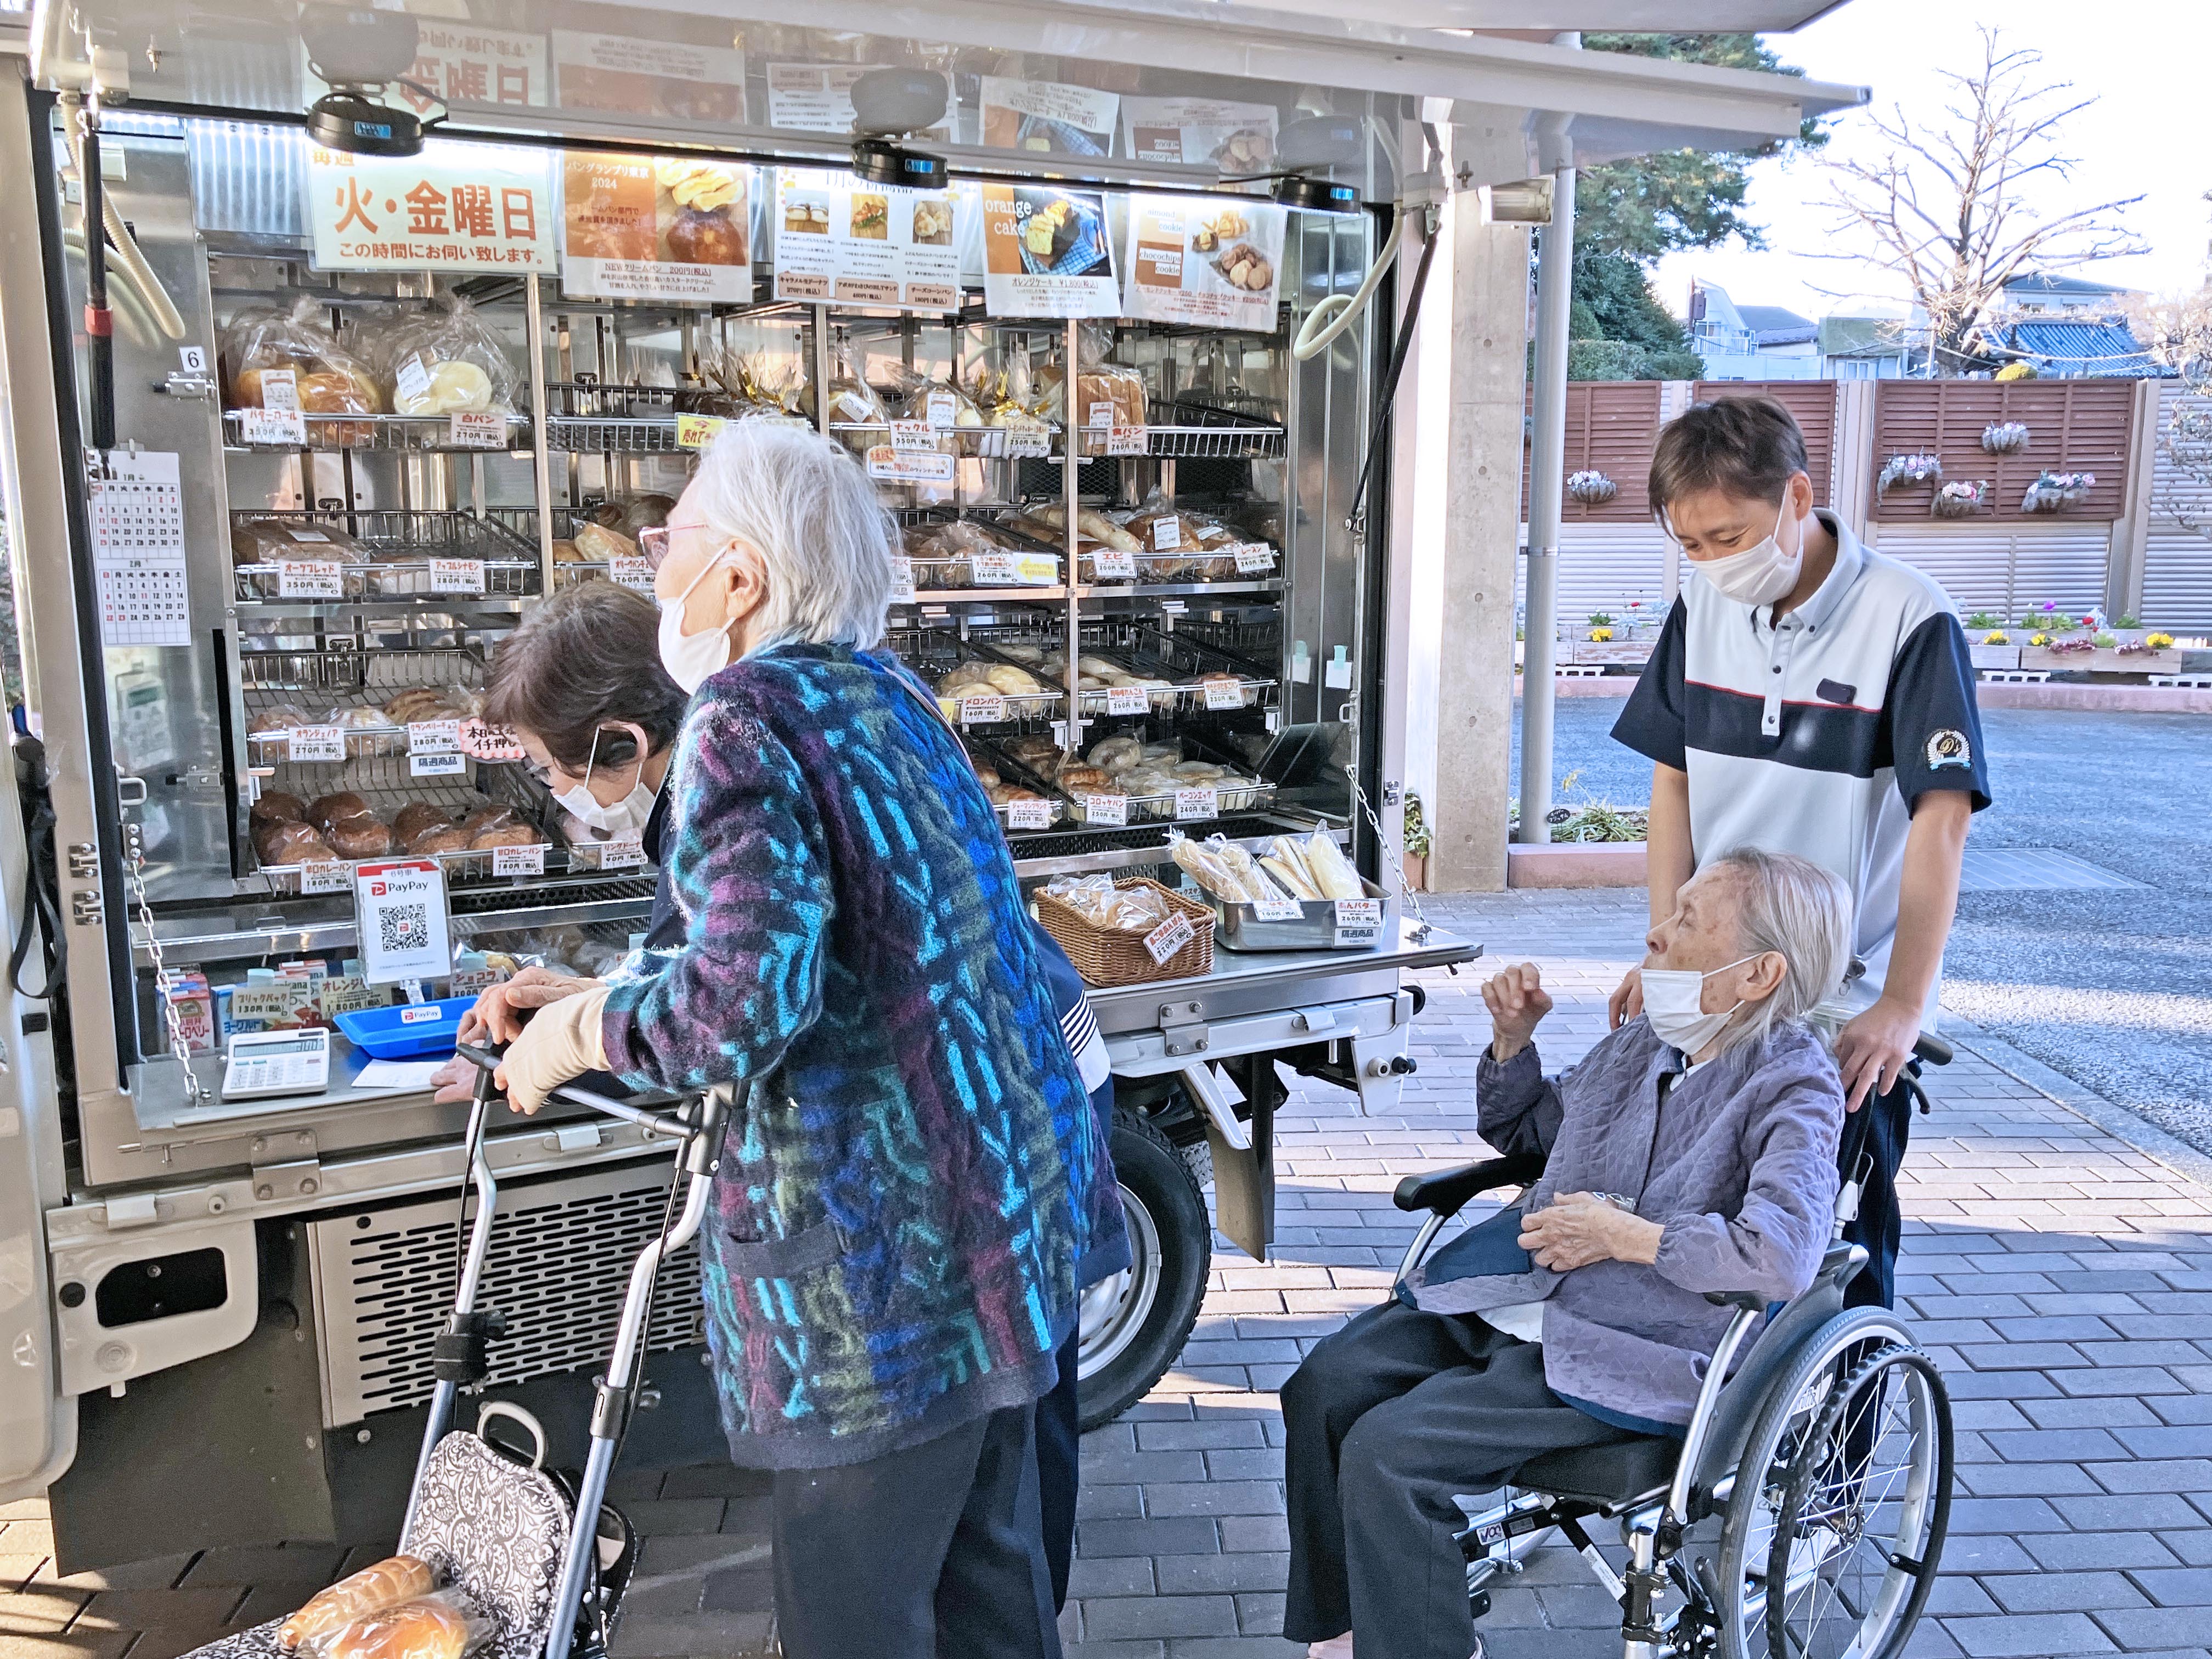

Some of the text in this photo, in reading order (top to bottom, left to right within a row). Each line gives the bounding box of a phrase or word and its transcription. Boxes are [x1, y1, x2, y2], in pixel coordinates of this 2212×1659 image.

[567, 162, 649, 179] パングランプリ東京
[592, 178, 617, 189] 2024
[334, 177, 538, 241] 火・金曜日
[985, 200, 1032, 218] orange
[1147, 208, 1176, 218] almond
[995, 219, 1025, 238] cake
[1159, 222, 1183, 232] cookie
[339, 242, 542, 265] この時間にお伺い致します。
[1139, 252, 1181, 264] chocochips
[1155, 266, 1180, 274] cookie
[1012, 277, 1053, 287] オレンジケーキ
[911, 286, 952, 296] チーズコーンパン
[188, 352, 200, 368] 6
[462, 414, 494, 424] 白パン
[894, 422, 930, 432] ナックル
[1112, 427, 1142, 436] 食パン
[682, 429, 711, 443] 売れて
[285, 562, 334, 573] オーツブレッド
[436, 561, 478, 571] アップルシナモン
[411, 721, 457, 731] クランベリーチョコ
[419, 756, 458, 768] 隔週商品
[1179, 791, 1211, 799] ベーコンエッグ
[1090, 797, 1124, 808] コロッケパン
[497, 848, 541, 856] 甘口カレーパン
[306, 862, 352, 874] 辛口カレーパン
[388, 881, 429, 893] PayPay
[1341, 929, 1374, 938] 隔週商品
[456, 970, 496, 983] ショコラ
[238, 993, 287, 1003] ブリックパック
[415, 1010, 438, 1018] PayPay
